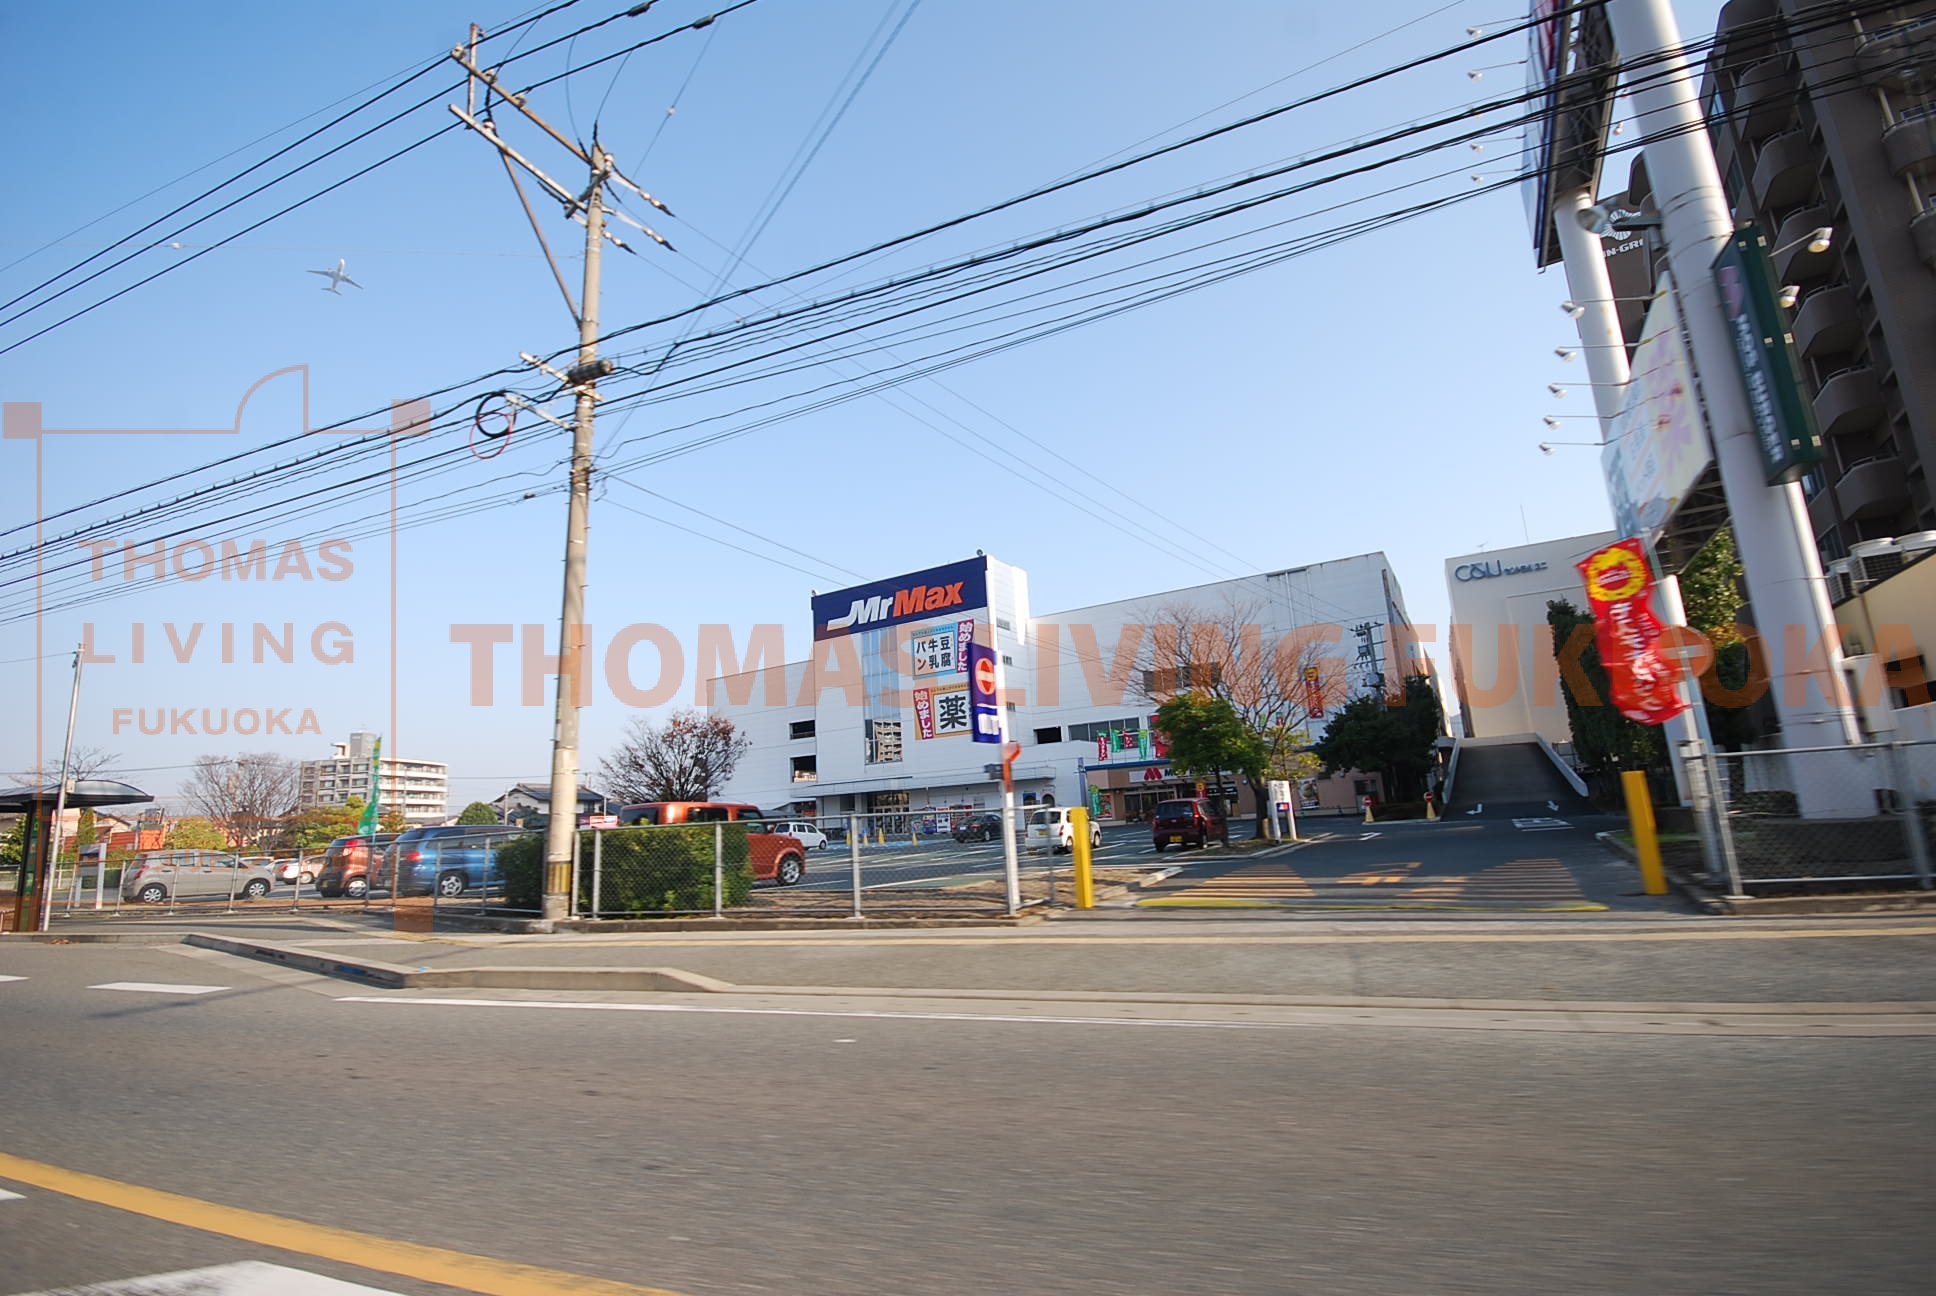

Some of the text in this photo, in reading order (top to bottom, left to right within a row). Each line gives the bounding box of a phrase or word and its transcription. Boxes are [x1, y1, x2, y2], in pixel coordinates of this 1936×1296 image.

[827, 581, 965, 631] MrMax
[928, 638, 940, 669] 牛乳
[914, 690, 933, 738] 始めました
[939, 694, 967, 730] 薬
